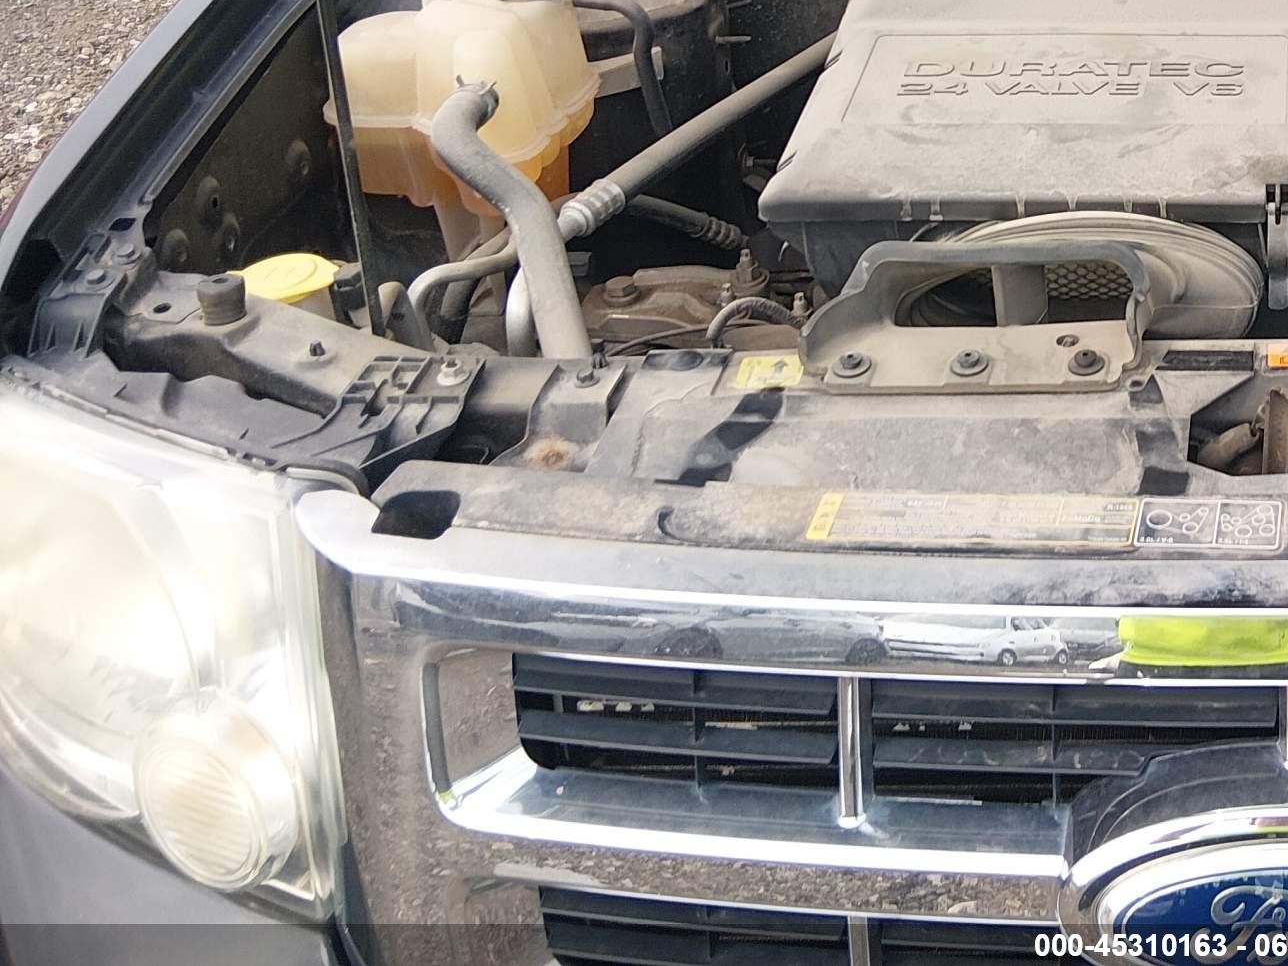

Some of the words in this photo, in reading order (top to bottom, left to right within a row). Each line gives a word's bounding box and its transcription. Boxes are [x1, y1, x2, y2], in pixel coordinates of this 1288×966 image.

[904, 60, 1245, 78] DURATEC
[896, 82, 969, 97] 24
[984, 81, 1141, 97] VALVE
[1172, 81, 1244, 97] V6
